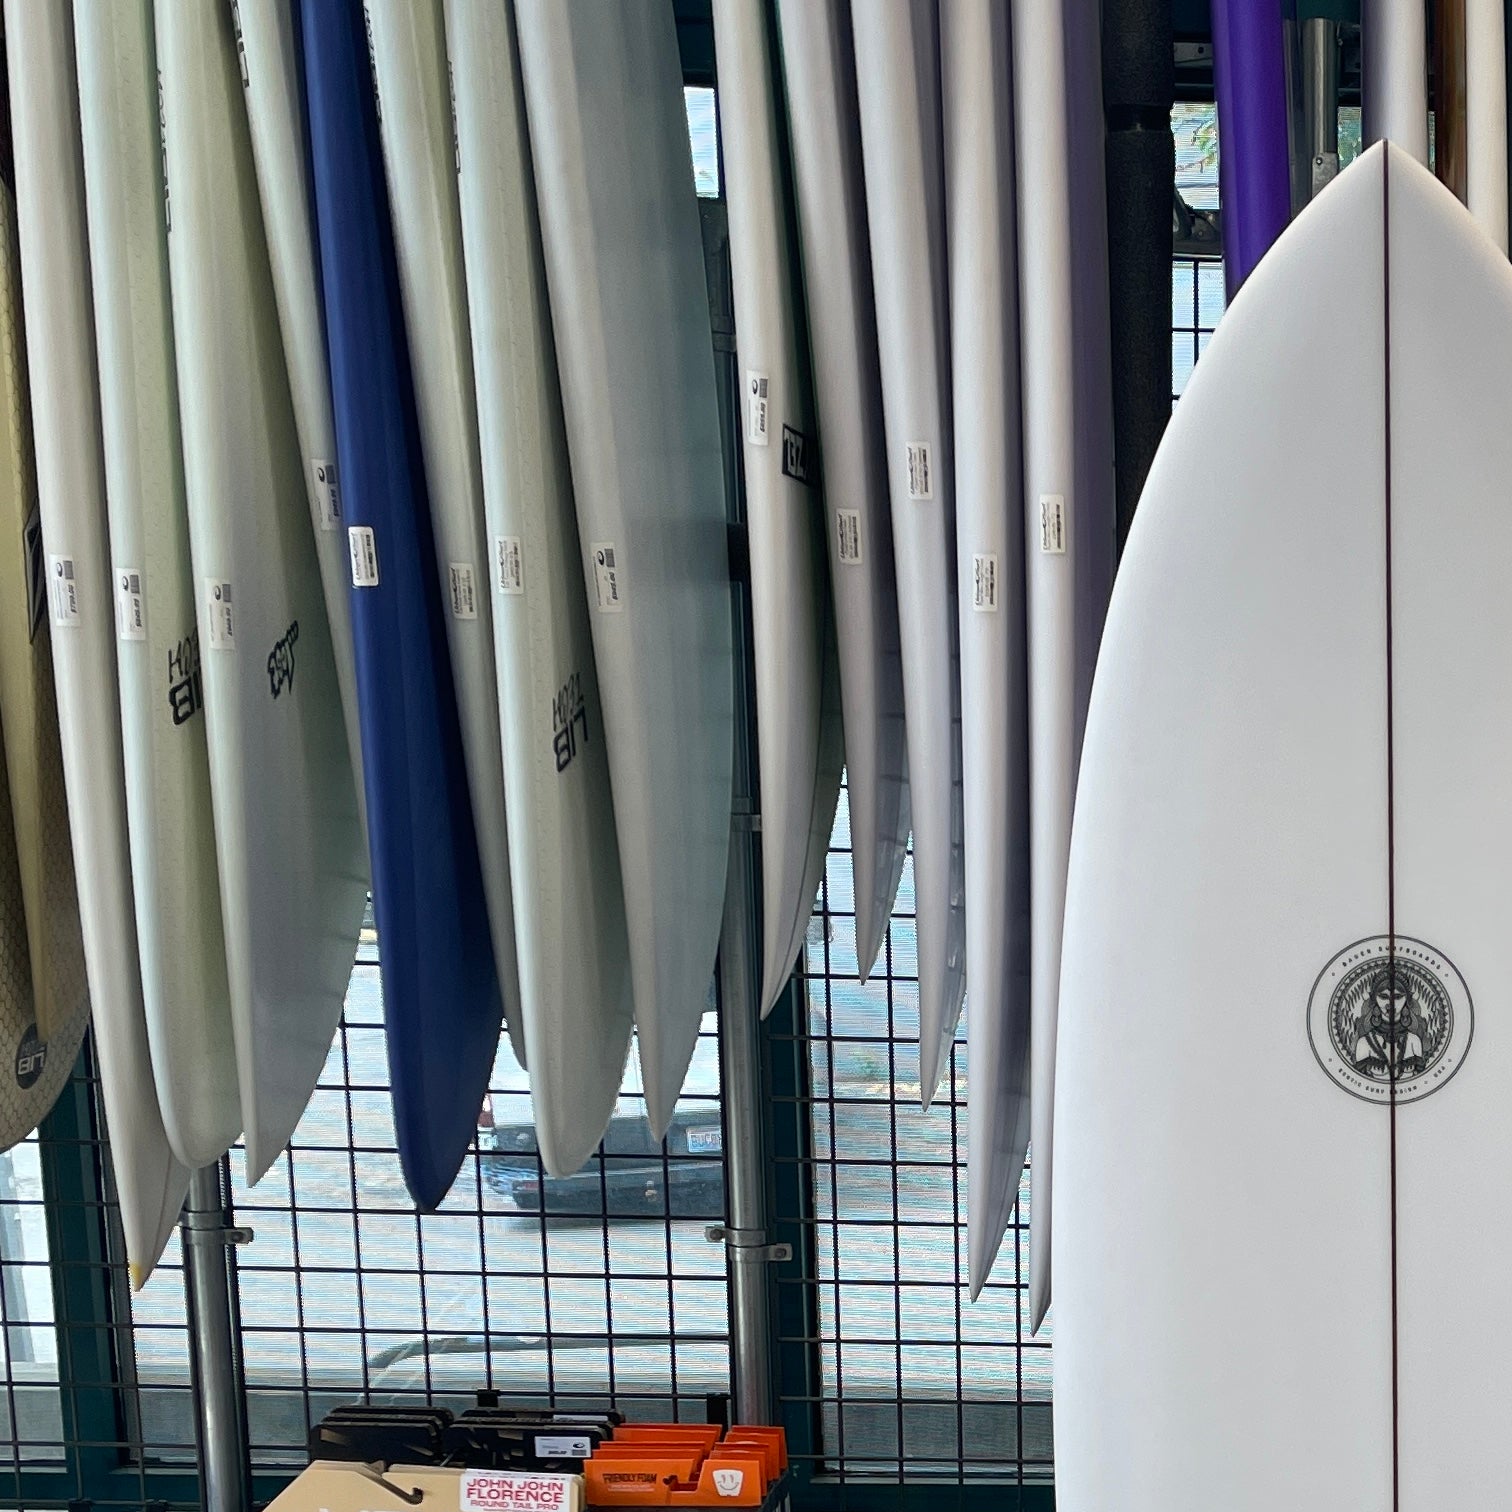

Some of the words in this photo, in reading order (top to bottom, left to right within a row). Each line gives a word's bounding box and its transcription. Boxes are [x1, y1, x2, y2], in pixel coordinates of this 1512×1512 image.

[466, 1478, 514, 1490] JOHN
[517, 1480, 565, 1492] JOHN
[466, 1488, 565, 1504] FLORENCE
[470, 1499, 509, 1509] ROUND
[512, 1502, 533, 1510] TAIL
[536, 1503, 559, 1511] PRO
